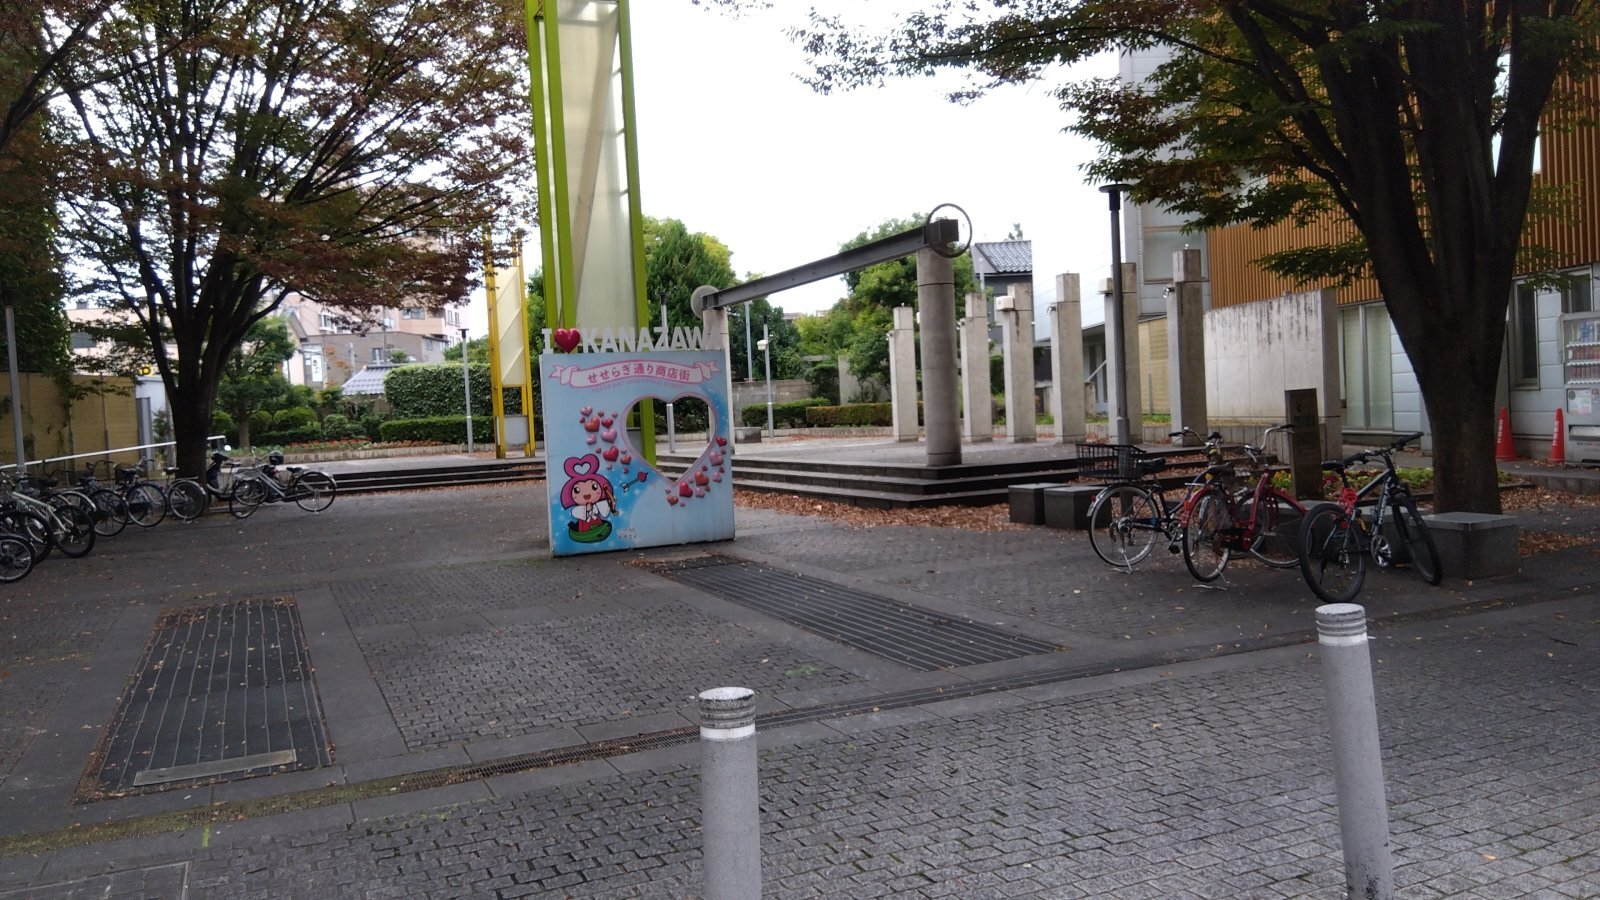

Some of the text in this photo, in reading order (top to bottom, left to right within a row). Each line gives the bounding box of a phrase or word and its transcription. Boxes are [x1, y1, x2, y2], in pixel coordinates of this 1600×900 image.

[541, 328, 553, 354] I
[587, 362, 690, 383] せせらぎ通り商店街
